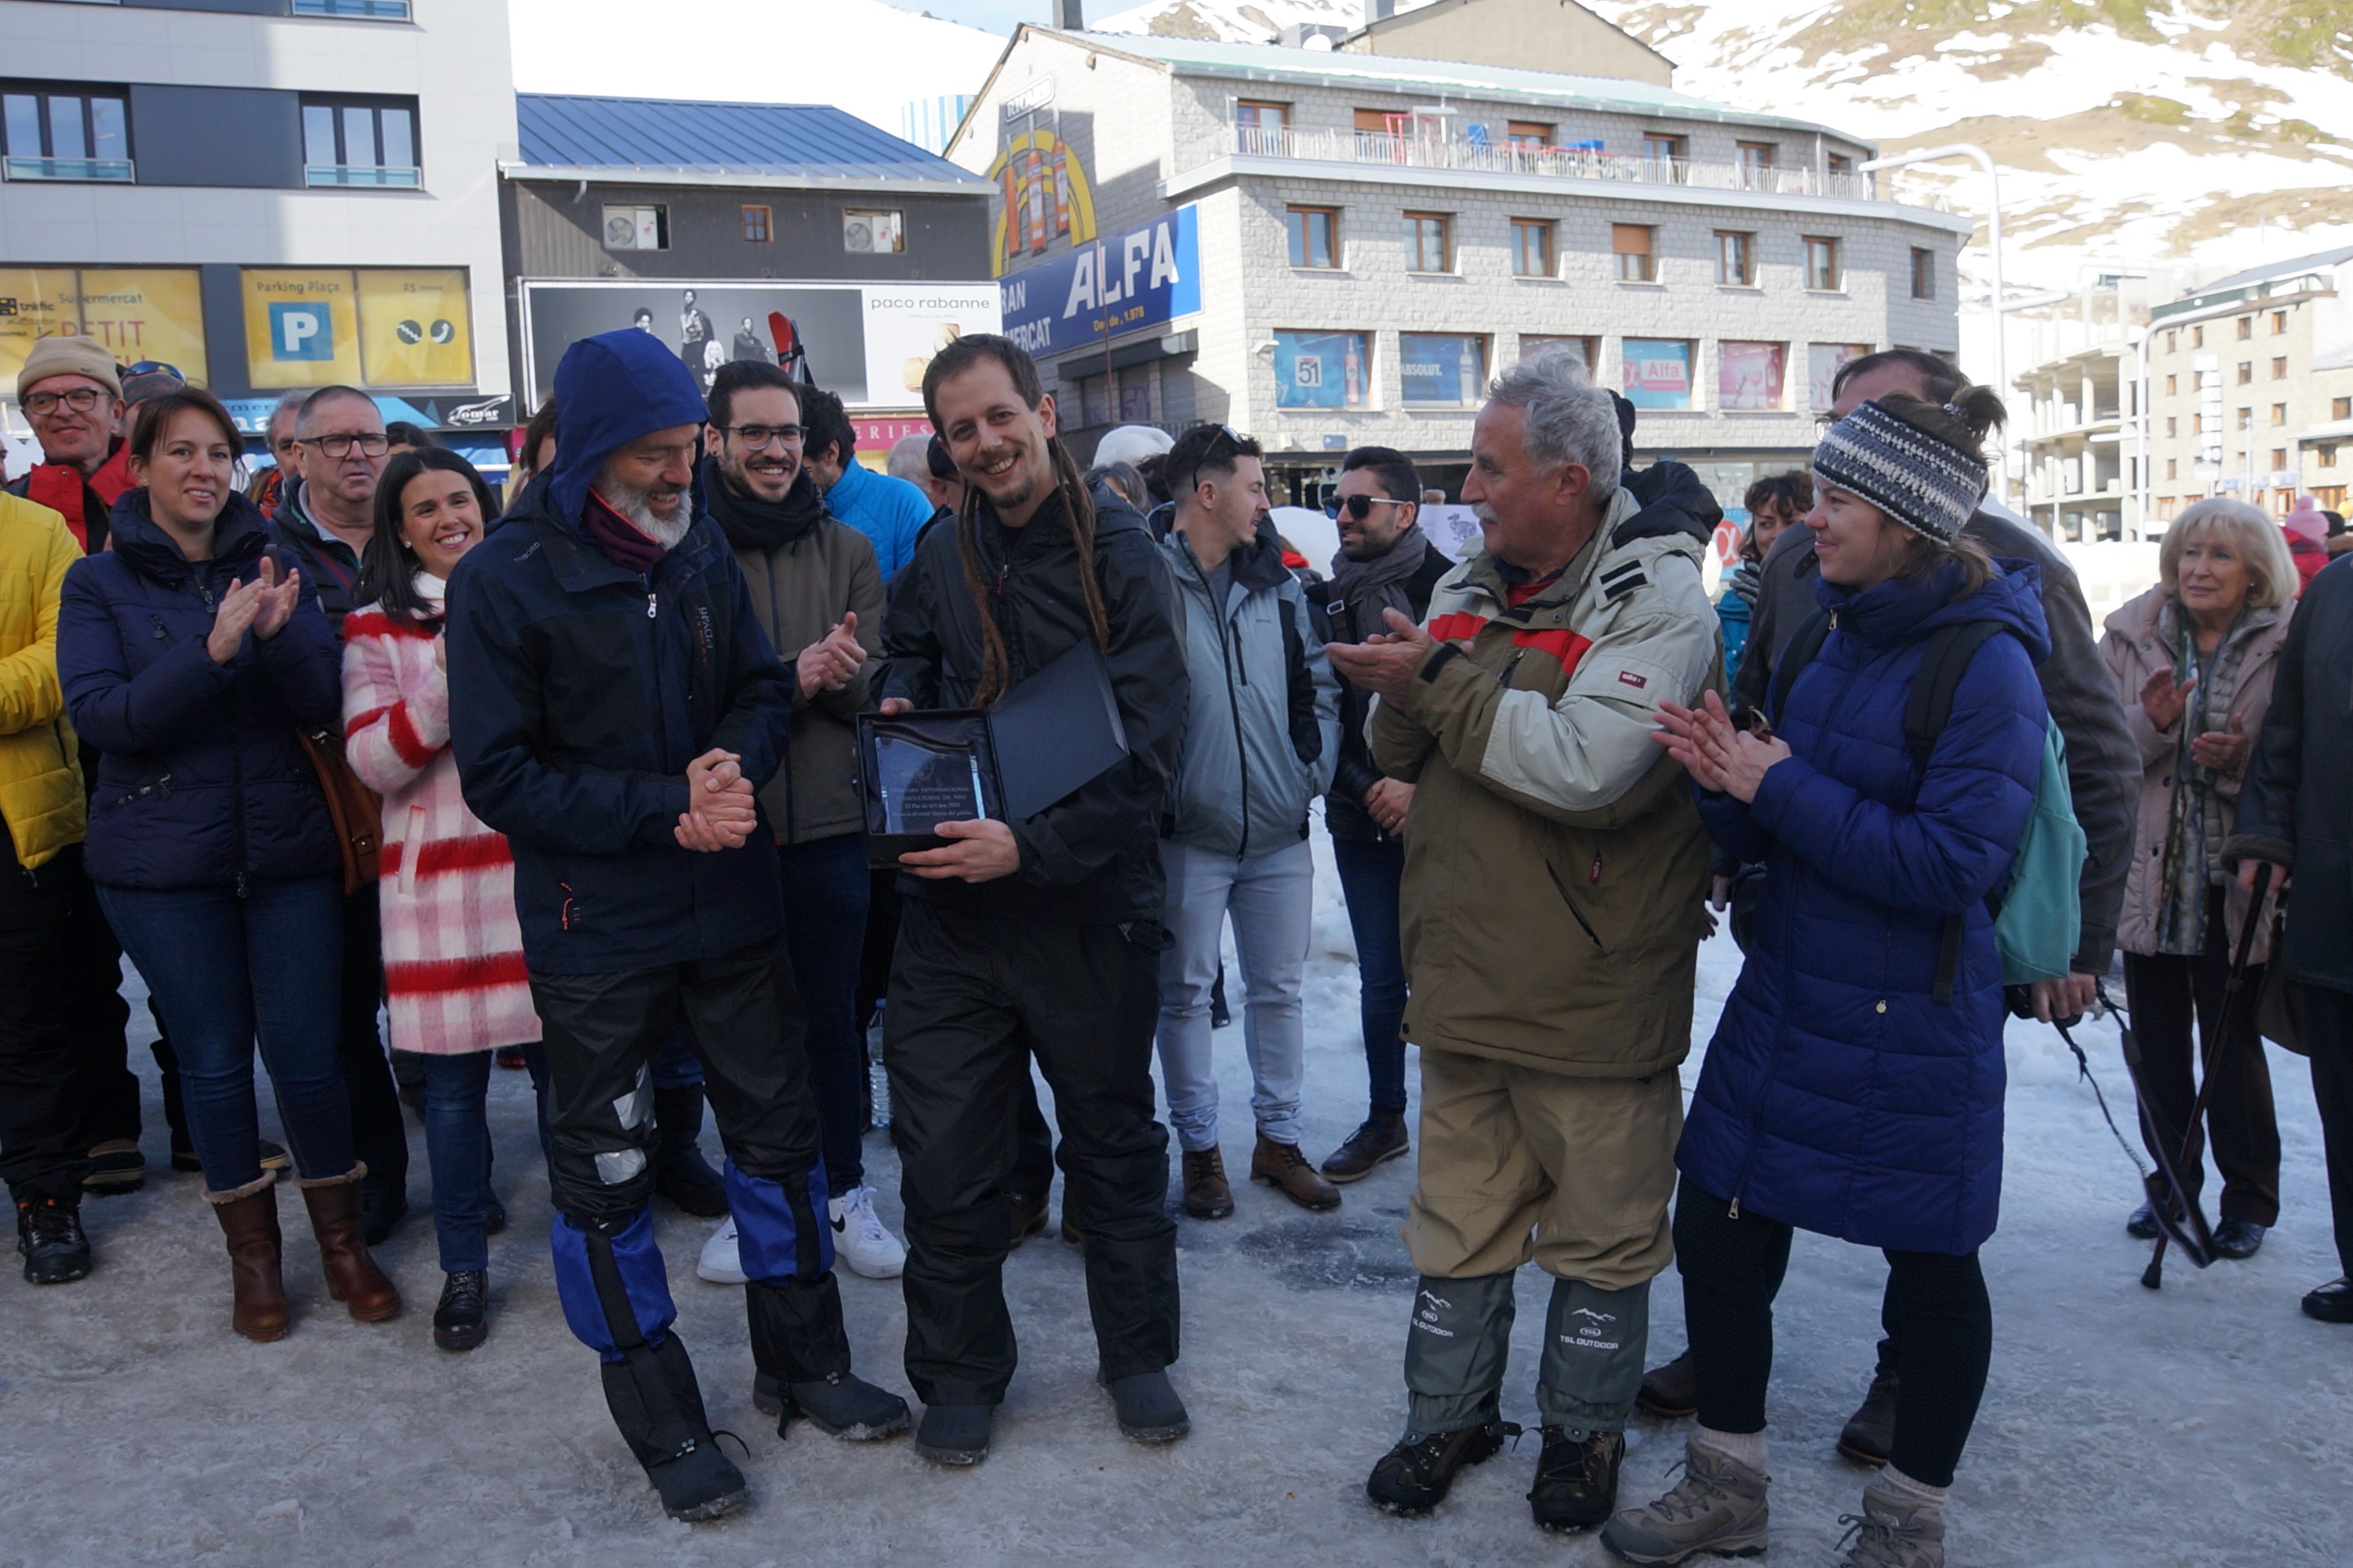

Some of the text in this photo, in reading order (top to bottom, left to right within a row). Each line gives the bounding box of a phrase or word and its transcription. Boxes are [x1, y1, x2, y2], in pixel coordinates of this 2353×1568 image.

[1063, 222, 1179, 319] ALFA
[257, 282, 340, 294] Parking Plaça
[403, 283, 415, 292] 25
[59, 293, 143, 304] Suermercat
[871, 297, 990, 310] paco rabanne
[282, 312, 319, 352] P
[1299, 362, 1320, 385] 51
[1648, 362, 1679, 378] Alfa
[1419, 1321, 1454, 1337] OUTDOOR
[1559, 1334, 1619, 1350] TSL OUTDOOR
